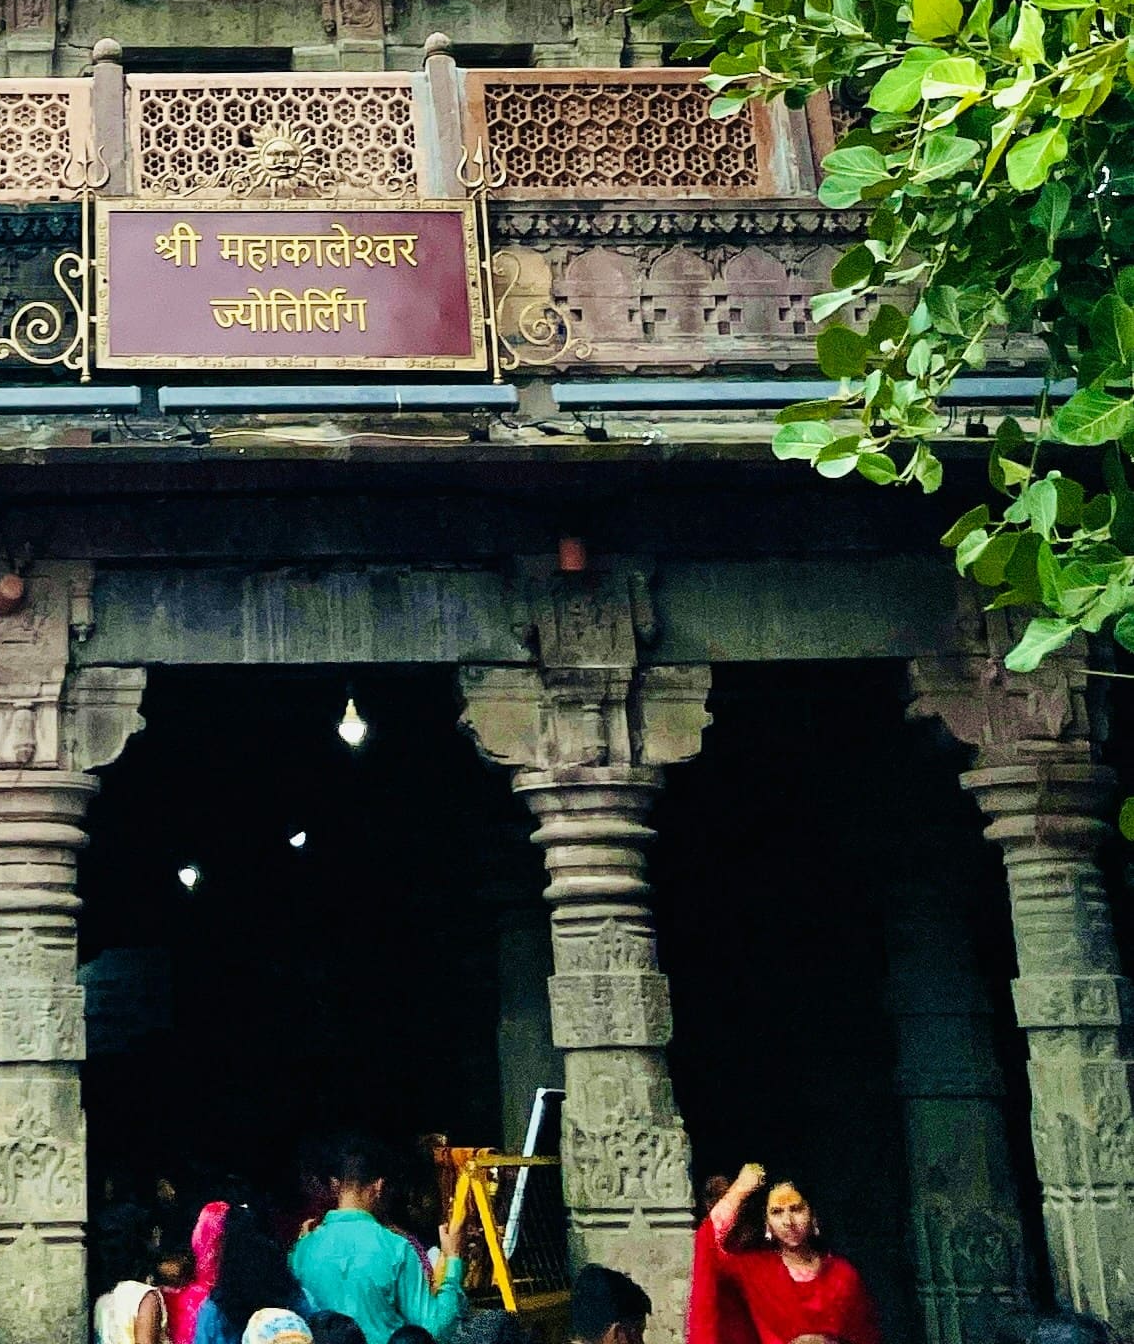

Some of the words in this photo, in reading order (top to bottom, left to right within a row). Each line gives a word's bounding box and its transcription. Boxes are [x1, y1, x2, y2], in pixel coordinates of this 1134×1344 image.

[153, 221, 202, 268] श्री
[217, 223, 419, 273] महाकालेश्वर
[209, 287, 368, 334] ज्योतिर्लिंग
